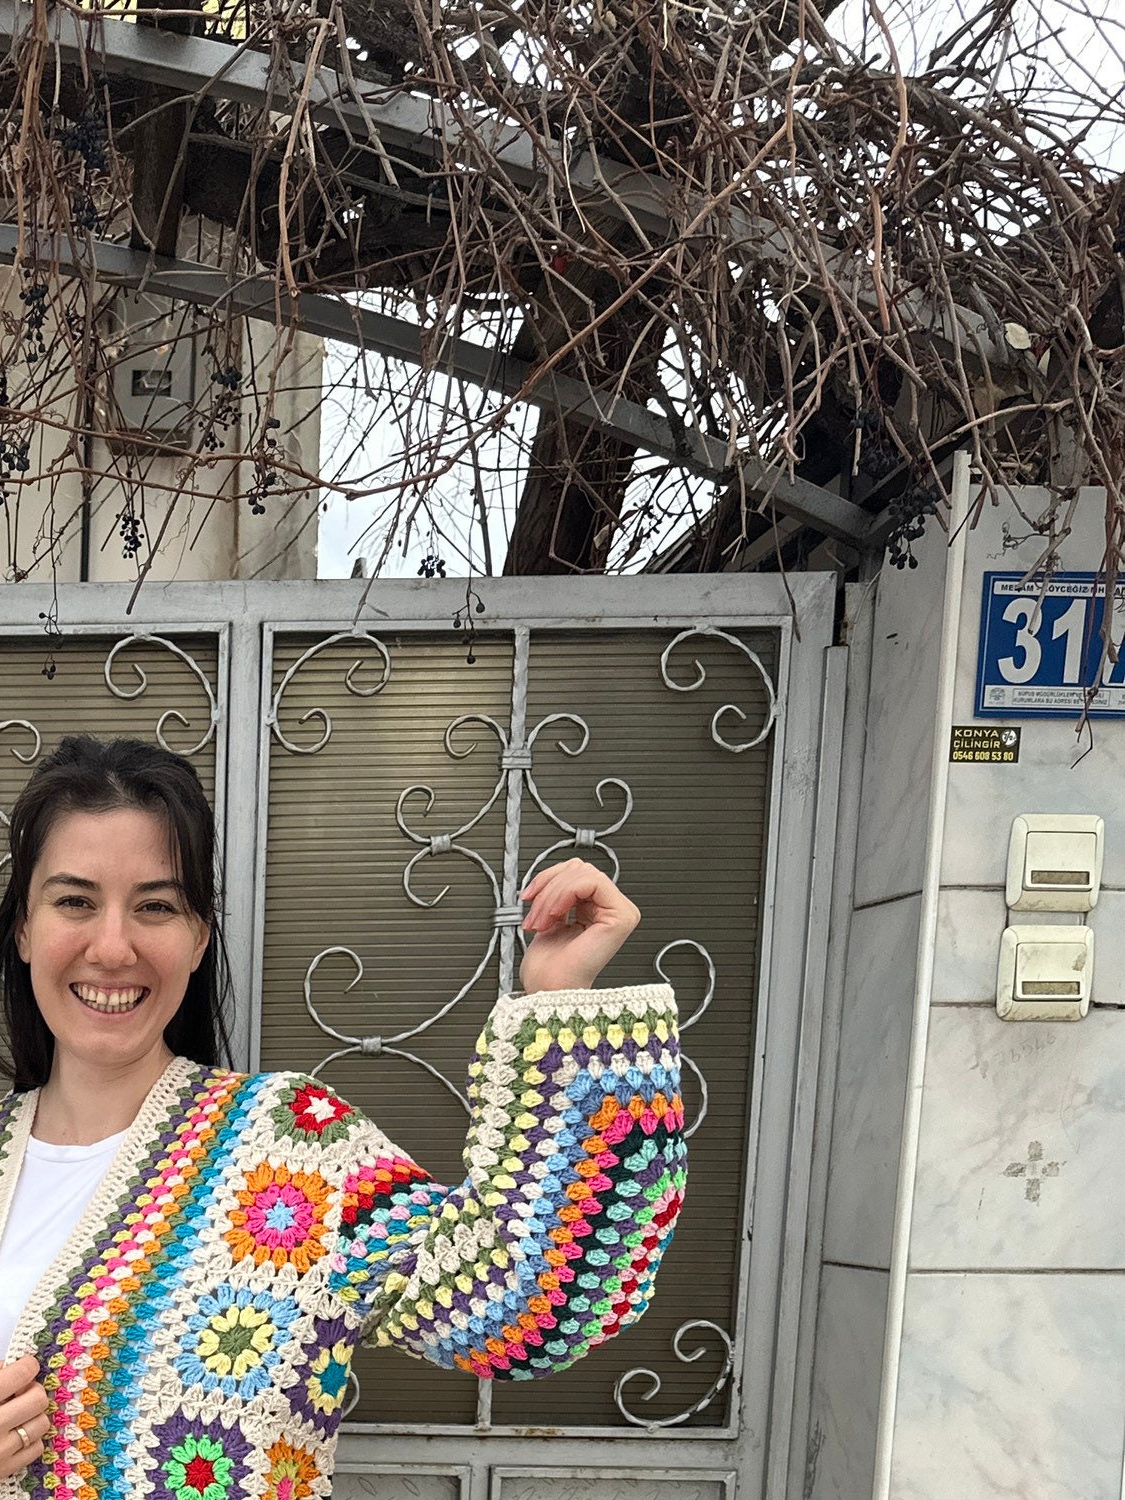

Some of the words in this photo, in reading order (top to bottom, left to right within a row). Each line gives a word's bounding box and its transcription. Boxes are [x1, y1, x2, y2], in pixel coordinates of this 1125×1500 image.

[1045, 584, 1086, 594] ÖYCEĞİZ
[997, 597, 1088, 684] 31
[954, 729, 999, 738] KONYA
[953, 738, 1001, 750] ÇİLİNGİR
[953, 751, 974, 760] 0546
[991, 752, 1002, 760] 53
